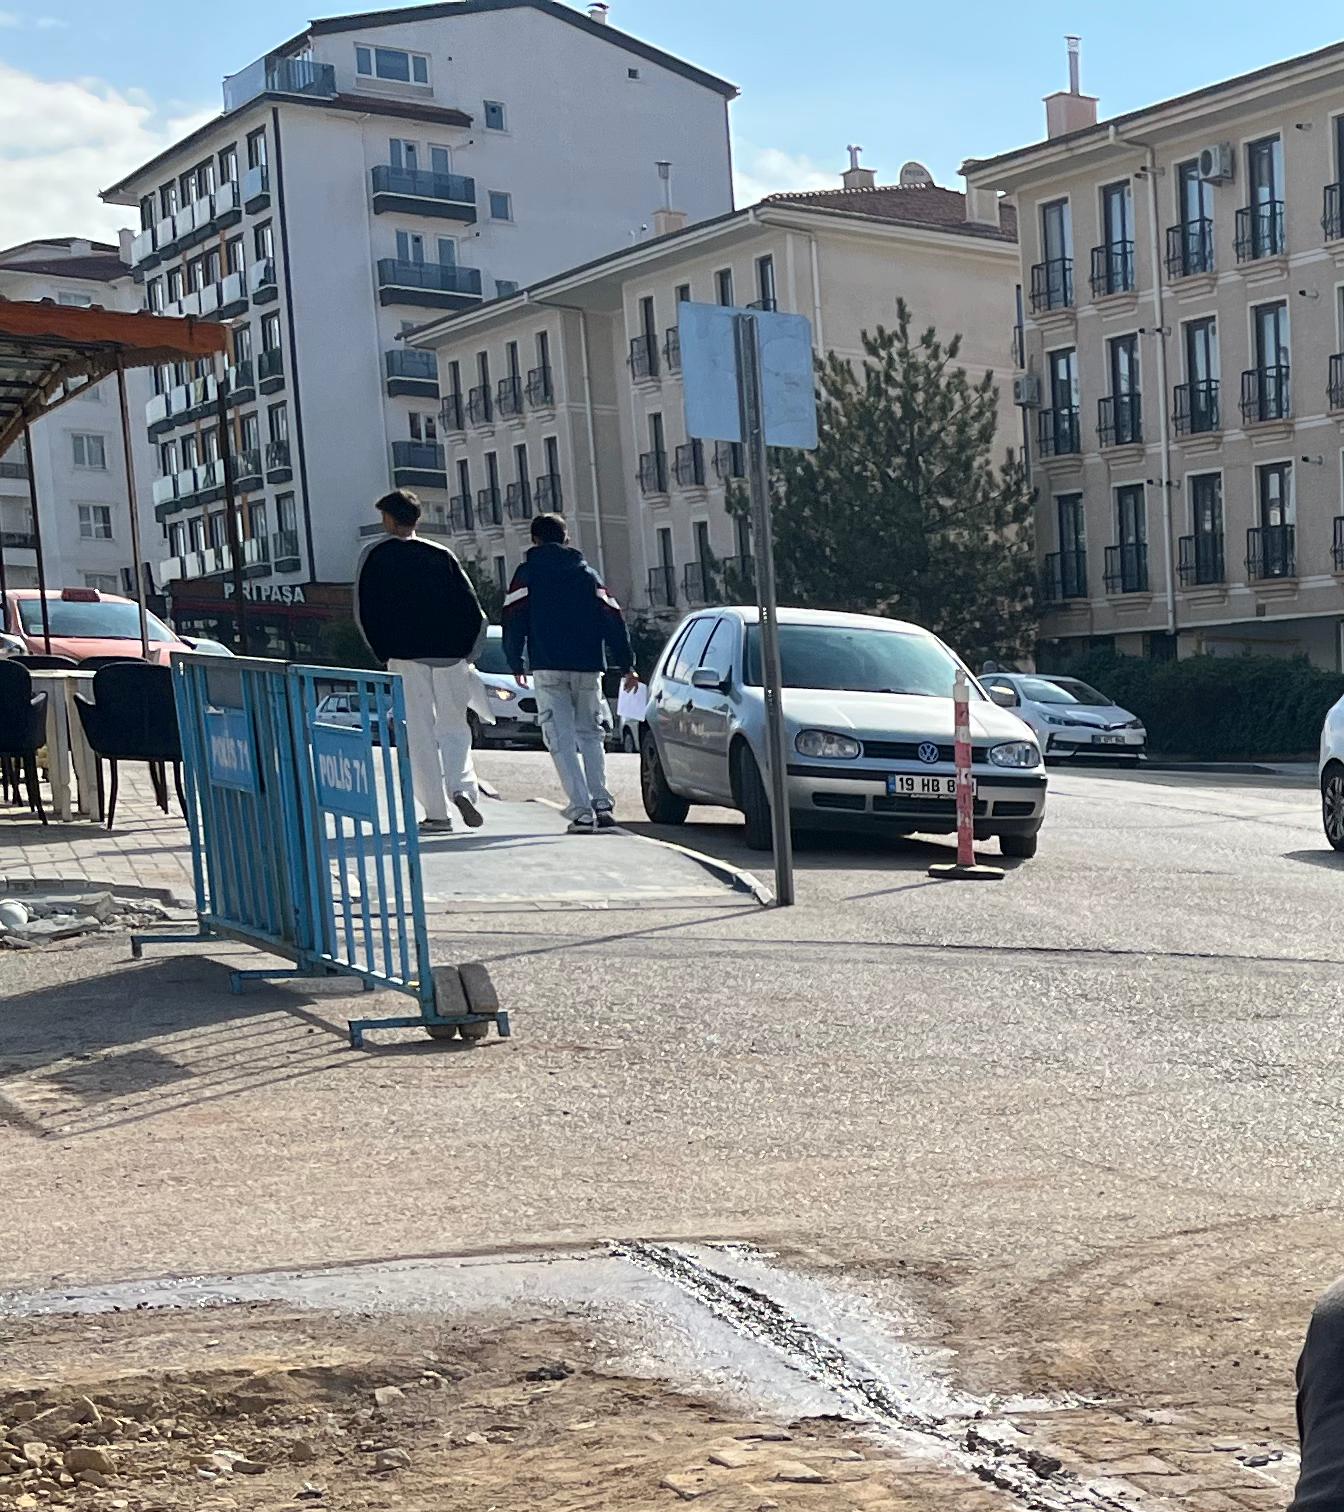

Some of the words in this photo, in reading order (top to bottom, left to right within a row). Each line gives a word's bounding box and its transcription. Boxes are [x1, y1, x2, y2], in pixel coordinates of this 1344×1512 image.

[318, 748, 352, 792] POLİS
[353, 759, 369, 795] 71
[899, 777, 914, 791] 19
[921, 778, 941, 792] HB
